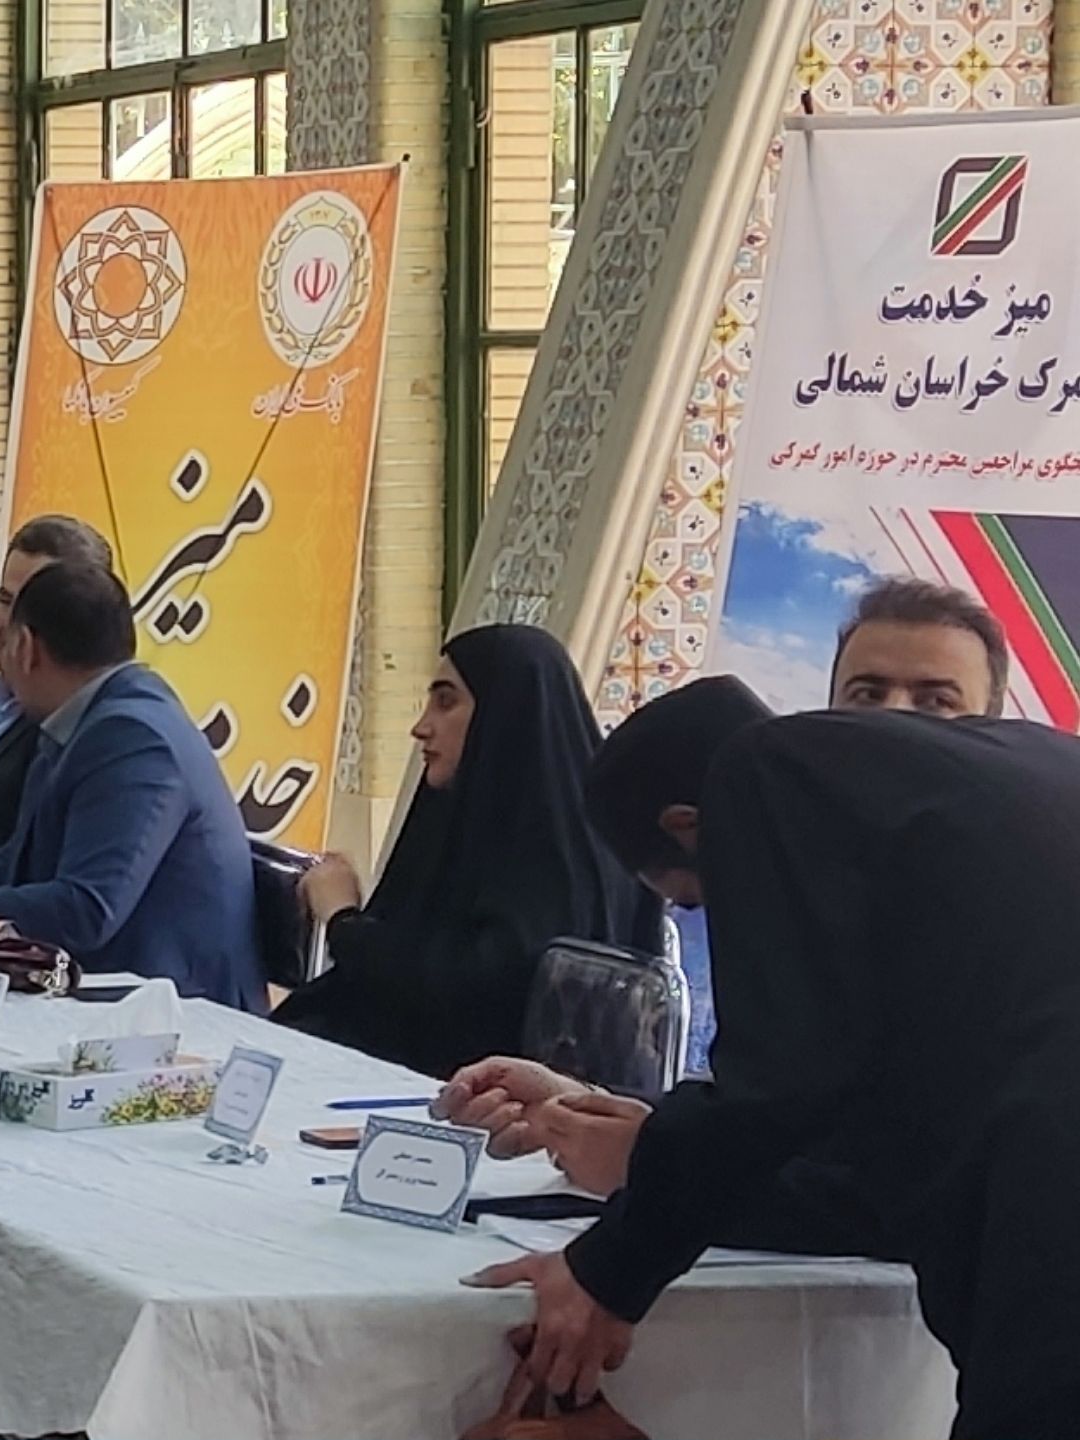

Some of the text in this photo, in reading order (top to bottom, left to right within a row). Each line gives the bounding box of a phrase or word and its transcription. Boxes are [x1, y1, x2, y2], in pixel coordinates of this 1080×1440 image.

[881, 274, 1051, 337] میز خدمت
[796, 353, 1080, 412] مرک خراسان شمالی
[770, 441, 821, 468] گمرکی
[823, 443, 855, 469] امور
[858, 448, 897, 472] حوزه
[900, 451, 919, 474] در
[132, 456, 267, 636] میز
